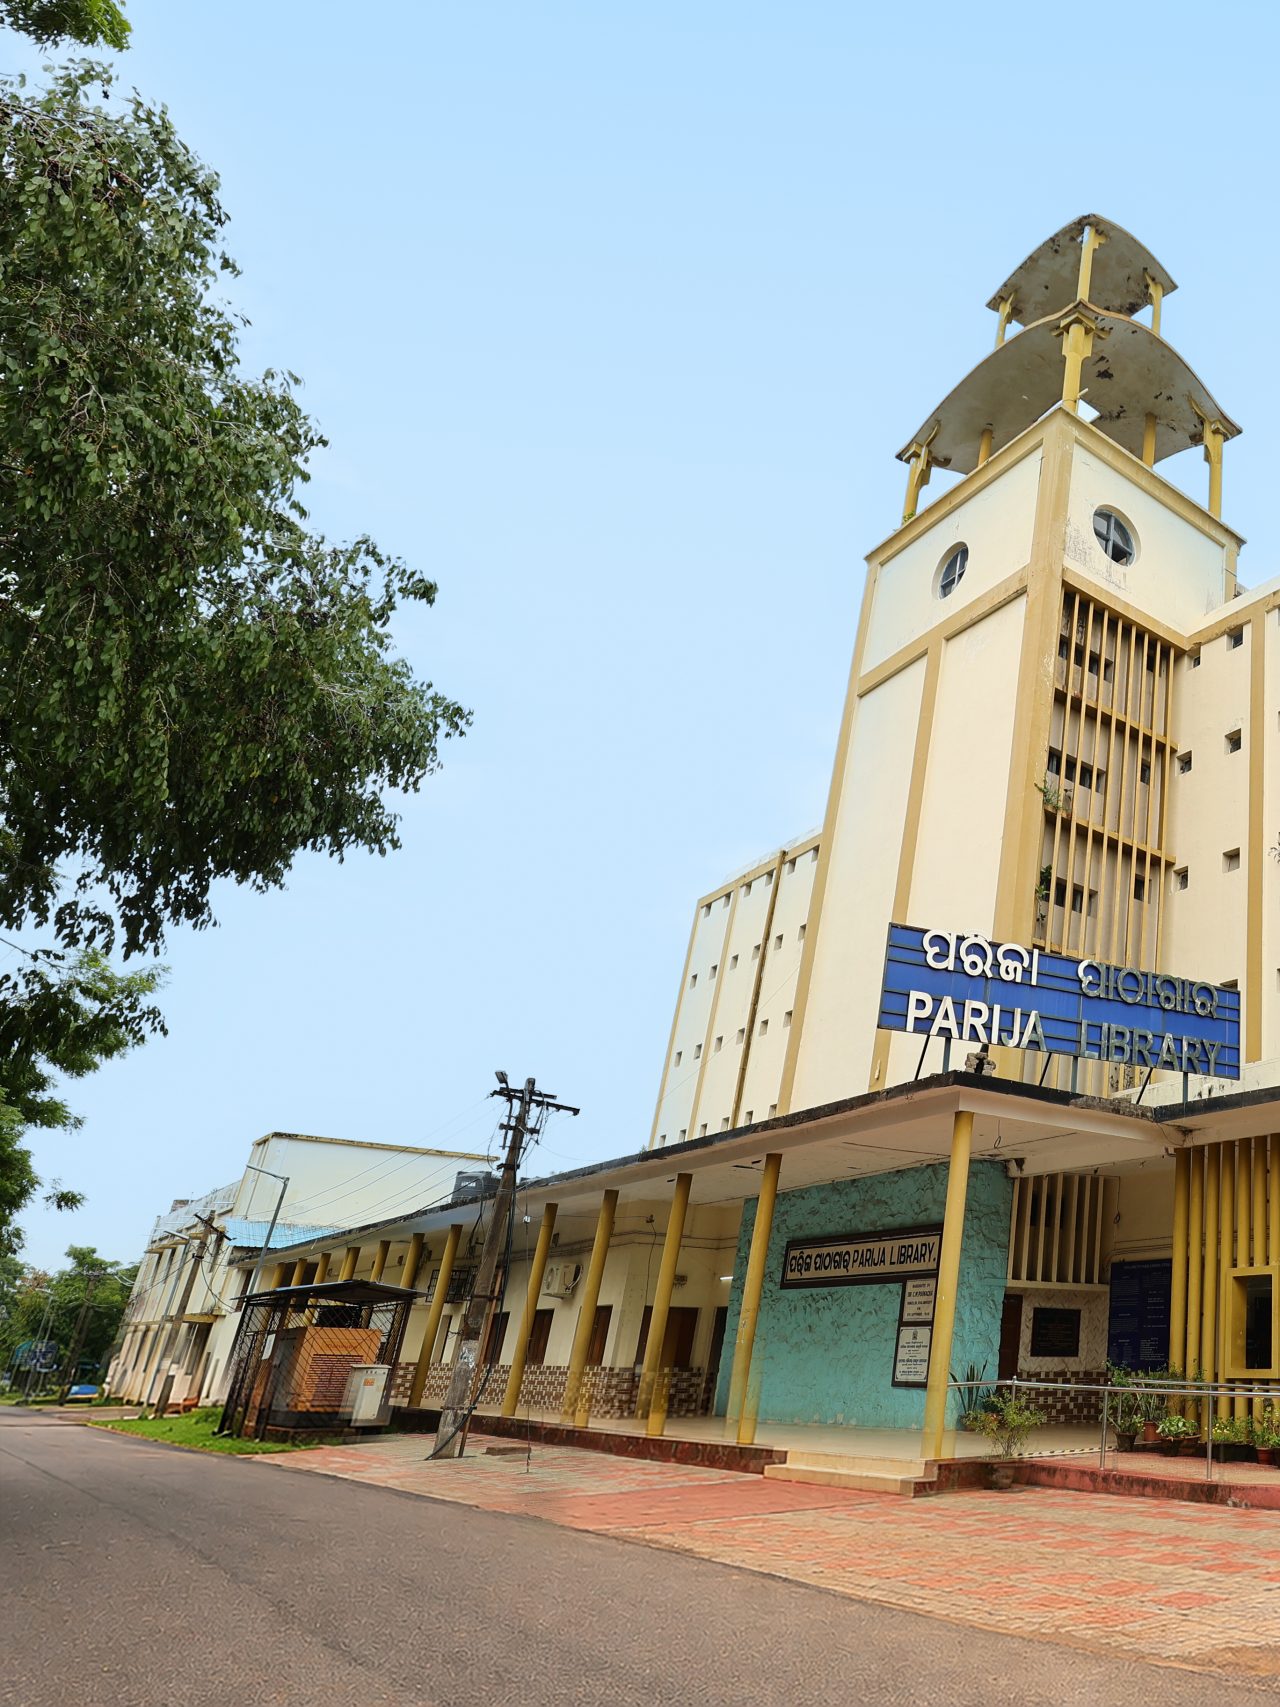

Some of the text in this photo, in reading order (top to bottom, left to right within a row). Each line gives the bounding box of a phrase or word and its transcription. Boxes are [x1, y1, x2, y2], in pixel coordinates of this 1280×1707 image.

[922, 929, 1219, 1018] ପରିଜା ପାଠାଗାର
[906, 990, 1222, 1077] PARIJA LIBRARY
[852, 1249, 886, 1268] PARIJA
[889, 1242, 936, 1265] LIBRARY.
